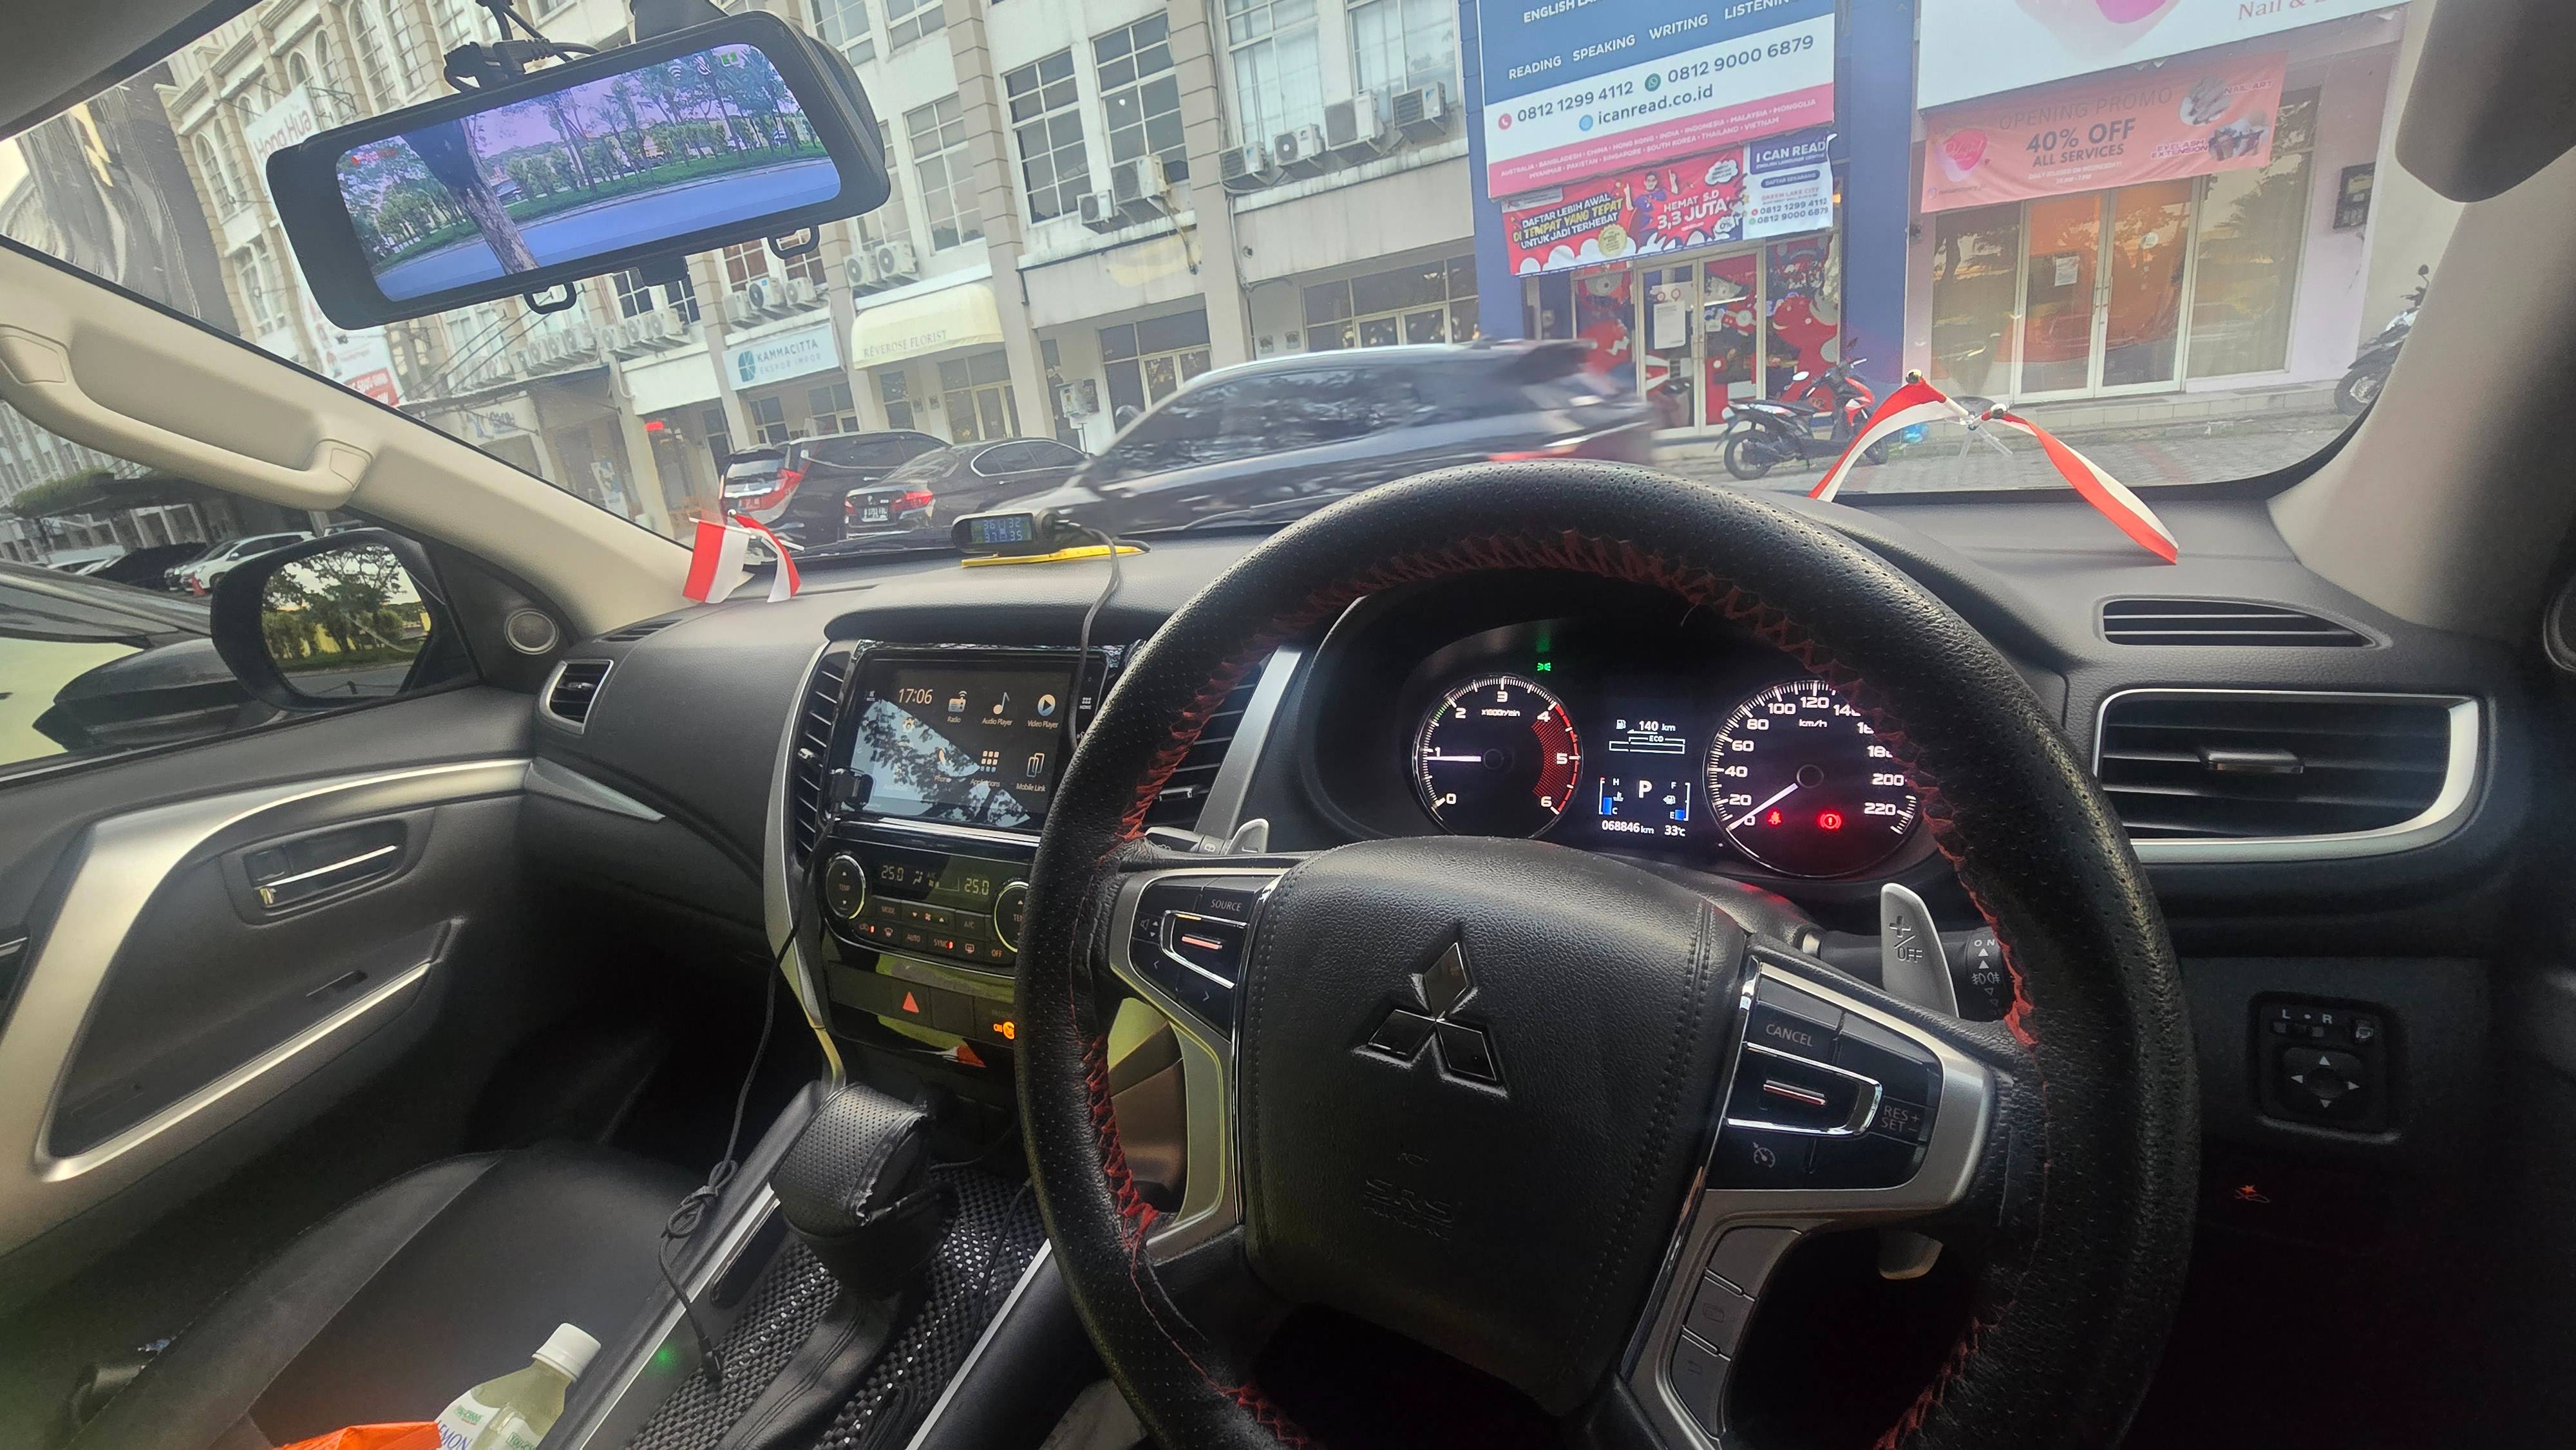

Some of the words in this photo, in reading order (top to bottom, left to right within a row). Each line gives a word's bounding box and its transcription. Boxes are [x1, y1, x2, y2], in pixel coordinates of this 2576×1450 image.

[1523, 0, 1575, 23] ENGLISH
[2239, 0, 2282, 20] Nail
[1509, 56, 1562, 79] READING
[1573, 34, 1636, 61] SPEAKING
[1649, 14, 1708, 39] WRITING
[1725, 0, 1789, 19] LISTENI
[1668, 61, 1709, 82] 0812
[1714, 48, 1762, 71] 9000
[1767, 35, 1814, 58] 6879
[2224, 84, 2247, 94] NAIL
[2252, 80, 2273, 89] ART
[1517, 102, 1553, 122] 0812
[1557, 91, 1594, 111] 1299
[1598, 81, 1633, 100] 4112
[1598, 84, 1713, 124] icanread.co.id
[2000, 102, 2088, 130] OPENING
[2096, 88, 2172, 114] PROMO
[283, 110, 312, 143] Hua
[1501, 164, 1535, 177] AUSTRALIA
[1539, 152, 1582, 167] BANGLADESH
[1587, 146, 1608, 156] CHINA
[1612, 140, 1633, 150] HONG
[1634, 135, 1654, 146] KONG
[1660, 129, 1680, 140] INDIA
[1685, 119, 1725, 134] INDONESIA
[1730, 109, 1768, 122] MALAYSIA
[1773, 99, 1816, 113] MONGOLIA
[2026, 127, 2079, 153] 40%
[2088, 118, 2136, 144] OFF
[1530, 167, 1562, 179] MYANMAR
[1566, 158, 1598, 171] PAKISTAN
[1603, 148, 1642, 162] SINGAPORE
[1647, 141, 1671, 152] SOUTH
[1672, 137, 1696, 146] KOREA
[1701, 126, 1739, 140] THAILAND
[1744, 117, 1779, 131] VIETNAM
[2157, 139, 2204, 151] EYELASH
[1756, 153, 1760, 163] I
[1763, 147, 1790, 161] CAN
[1792, 141, 1826, 156] READ
[2032, 155, 2056, 167] ALL
[2060, 143, 2125, 164] SERVICES
[2151, 146, 2208, 158] EXTENSION
[1762, 193, 1785, 201] GREEN
[1663, 195, 1699, 213] HEMAT
[1760, 205, 1781, 214] 0812
[1784, 202, 1806, 211] 1299
[1522, 212, 1556, 229] DAFTAR
[1557, 202, 1582, 218] LEBIH
[1584, 194, 1611, 209] AWAL
[1757, 214, 1779, 223] 0812
[1781, 211, 1806, 220] 9000
[1808, 207, 1828, 216] 6879
[1513, 231, 1522, 242] DI
[1524, 218, 1562, 238] TEMPAT
[1564, 211, 1589, 227] YANG
[1592, 198, 1624, 217] TEPAT
[1658, 211, 1681, 230] 3,3
[1521, 234, 1549, 249] UNTUK
[1550, 228, 1571, 241] JADI
[1572, 212, 1618, 234] TERHEBAT
[910, 330, 947, 348] FLORIST
[757, 339, 819, 362] KAMMACITTA
[759, 360, 791, 375] EKSPOR
[794, 353, 821, 365] IMPOR
[1009, 518, 1021, 527] 32
[984, 532, 997, 543] 37
[1010, 531, 1023, 541] 35
[898, 688, 933, 704] 17:06
[1497, 691, 1508, 702] 3
[1800, 696, 1830, 708] 120
[1455, 708, 1466, 719] 2
[1768, 702, 1796, 715] 100
[947, 715, 961, 724] Radio
[981, 717, 995, 726] Audio
[996, 717, 1013, 728] Player
[1537, 711, 1551, 722] 4
[1027, 719, 1040, 728] Video
[1041, 720, 1059, 730] Player
[1639, 720, 1659, 731] 140
[1661, 723, 1676, 732] km
[1747, 719, 1769, 730] 80
[1799, 719, 1828, 728] km/h
[1857, 722, 1875, 734] 16
[1434, 746, 1441, 757] 1
[1732, 740, 1754, 752] 60
[1556, 753, 1568, 765] 5
[1725, 766, 1748, 778] 40
[1613, 778, 1620, 786] H
[1871, 773, 1904, 786] 200
[1016, 782, 1034, 791] Mobile
[1034, 784, 1046, 793] Link
[1638, 780, 1653, 798] P
[1446, 793, 1457, 804] 0
[1540, 796, 1552, 807] 6
[1729, 794, 1752, 806] 20
[1612, 807, 1618, 815] C
[1669, 811, 1675, 820] E
[1864, 802, 1896, 816] 220
[1744, 814, 1756, 826] 0
[1602, 820, 1641, 834] 068846
[1641, 825, 1655, 835] km
[881, 865, 904, 882] 25.0
[964, 877, 990, 896] 25.0
[881, 905, 896, 916] MODE
[1211, 898, 1242, 912] SOURCE
[906, 934, 921, 943] AUTO
[934, 938, 948, 948] SYNC
[1974, 939, 1995, 947] ON
[991, 948, 1003, 957] OFF
[1897, 947, 1922, 963] OFF
[2282, 1009, 2291, 1019] L
[2322, 1013, 2333, 1024] R
[1766, 1023, 1814, 1047] CANCEL
[1884, 1106, 1908, 1122] RES
[1881, 1118, 1906, 1133] SET
